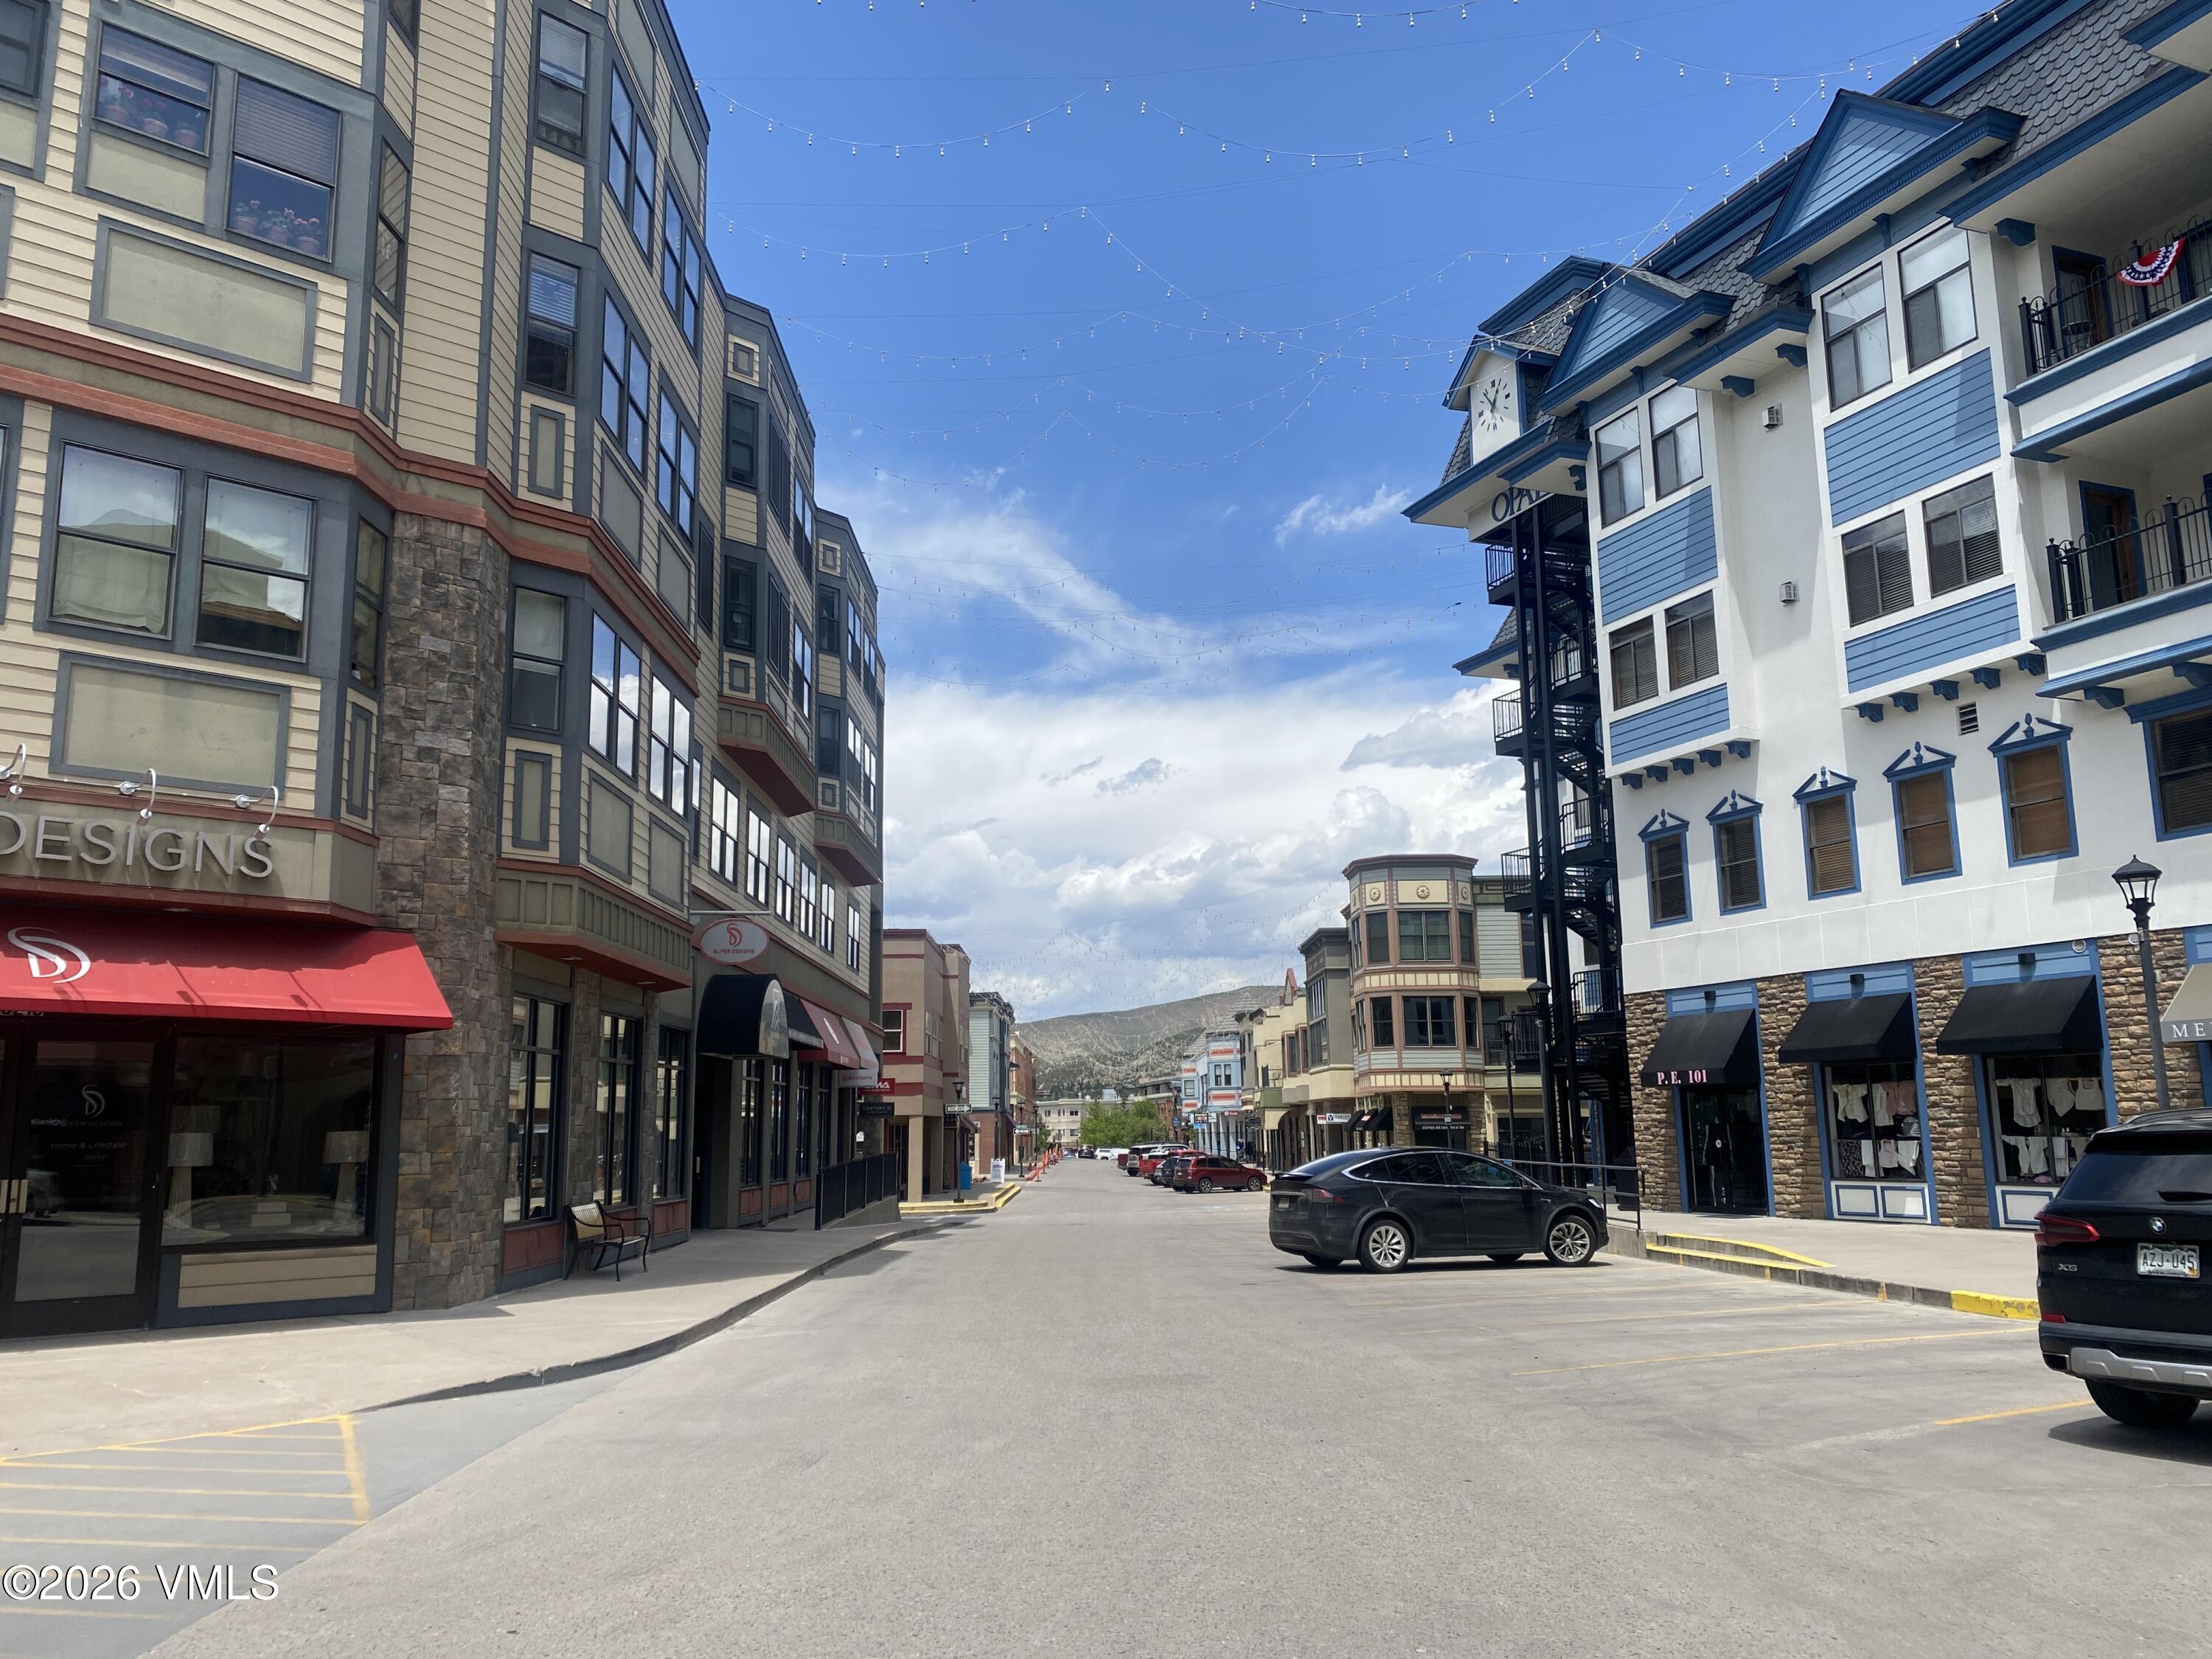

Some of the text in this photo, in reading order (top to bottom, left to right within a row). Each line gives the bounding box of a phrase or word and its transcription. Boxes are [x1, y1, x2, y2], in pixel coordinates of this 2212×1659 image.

[0, 812, 274, 878] DESIGNS
[2171, 1022, 2212, 1038] ME
[1689, 1070, 1707, 1083] 101
[2058, 1263, 2078, 1272] X5
